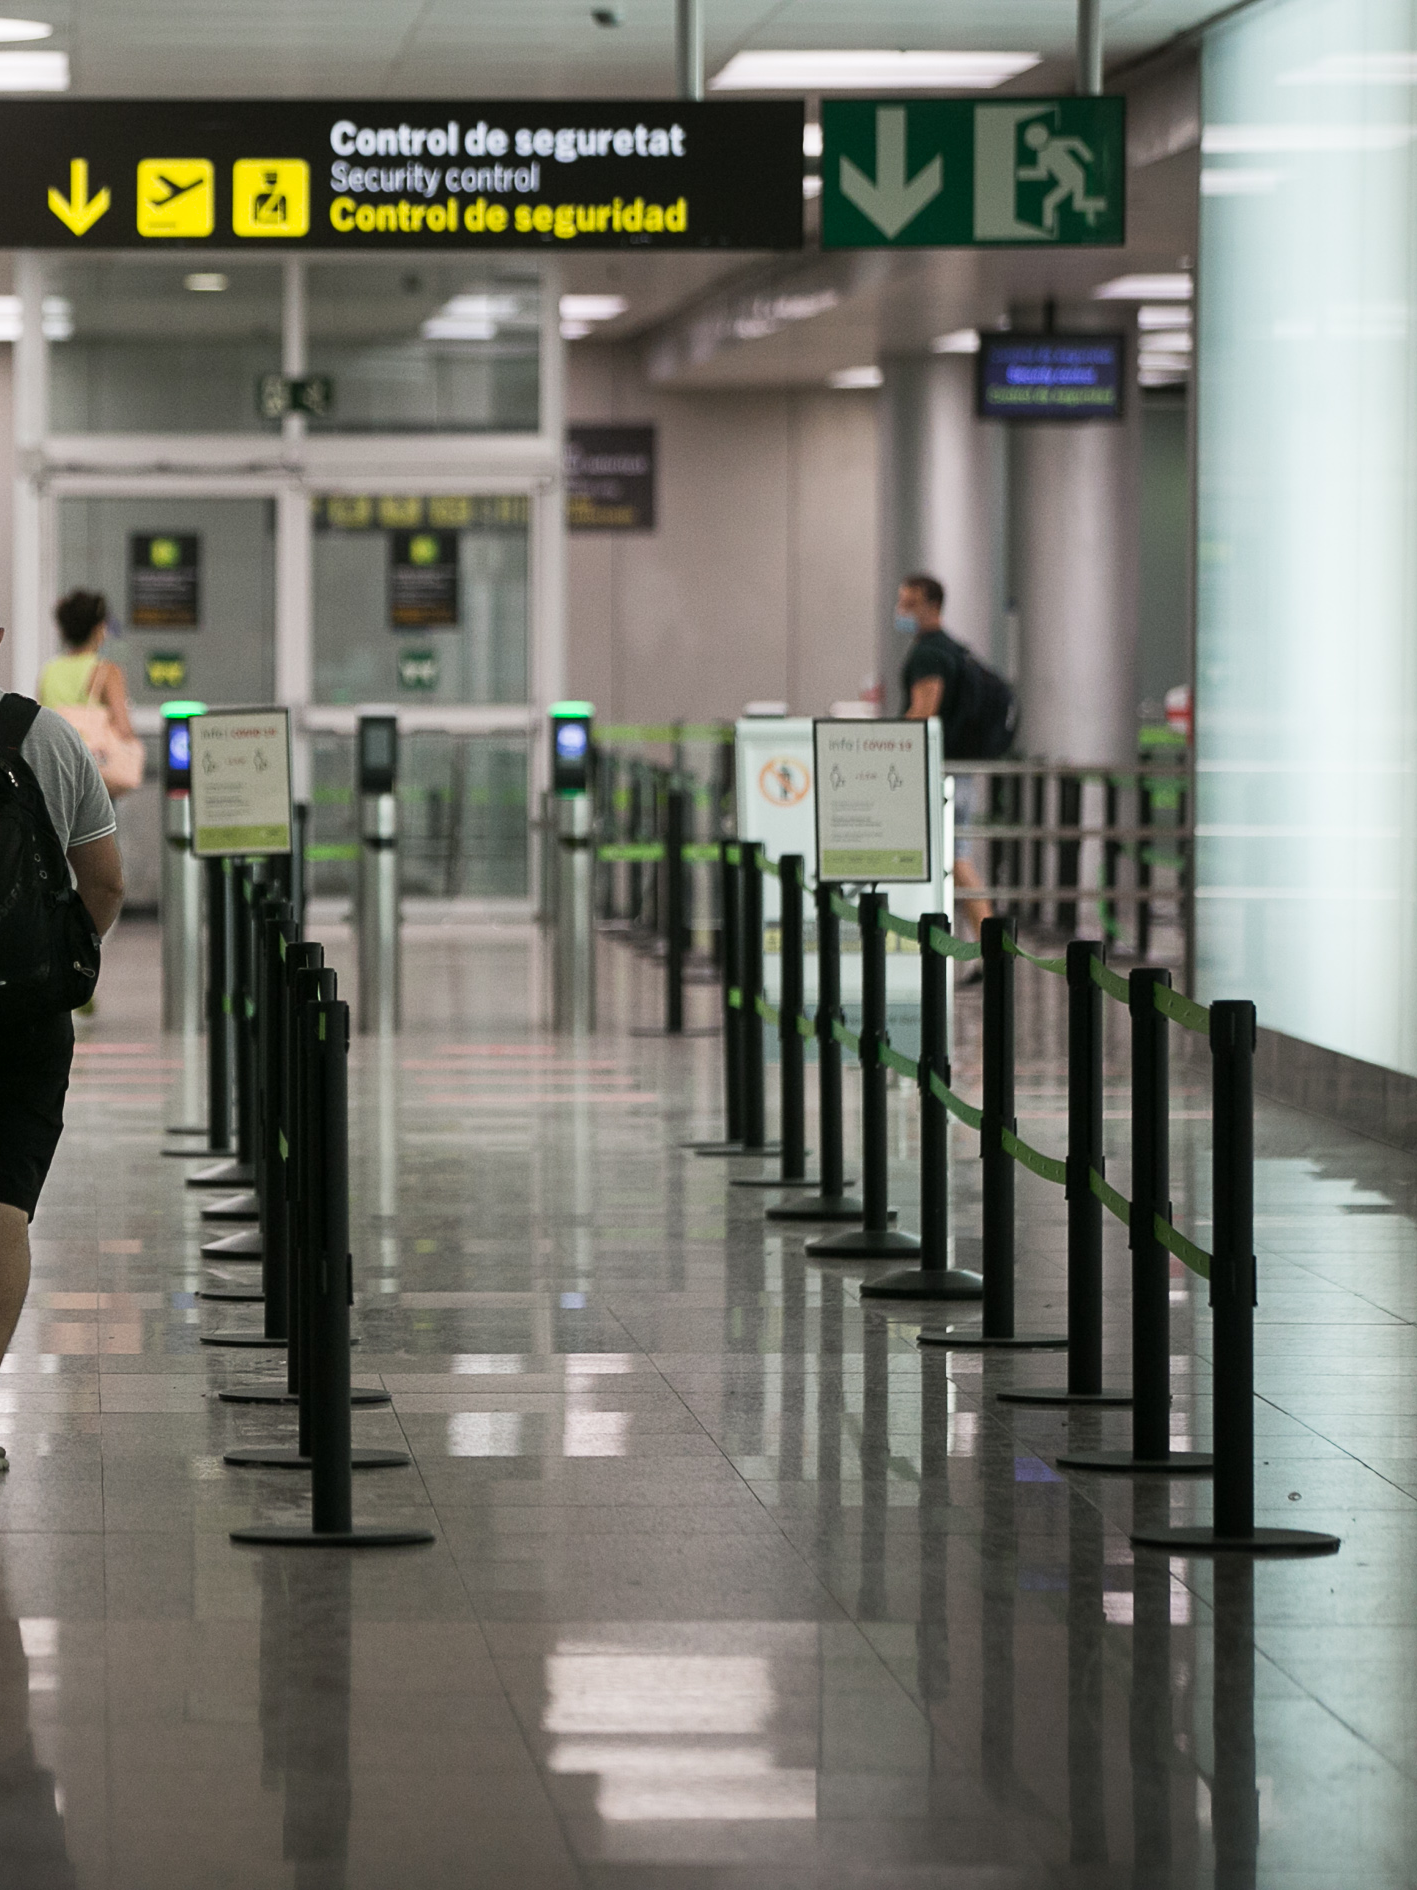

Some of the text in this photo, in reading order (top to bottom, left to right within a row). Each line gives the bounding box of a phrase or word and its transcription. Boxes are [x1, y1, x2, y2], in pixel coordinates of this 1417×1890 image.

[330, 120, 685, 163] Control de seguretat
[330, 160, 541, 197] Security control
[330, 196, 687, 238] Control de seguridad
